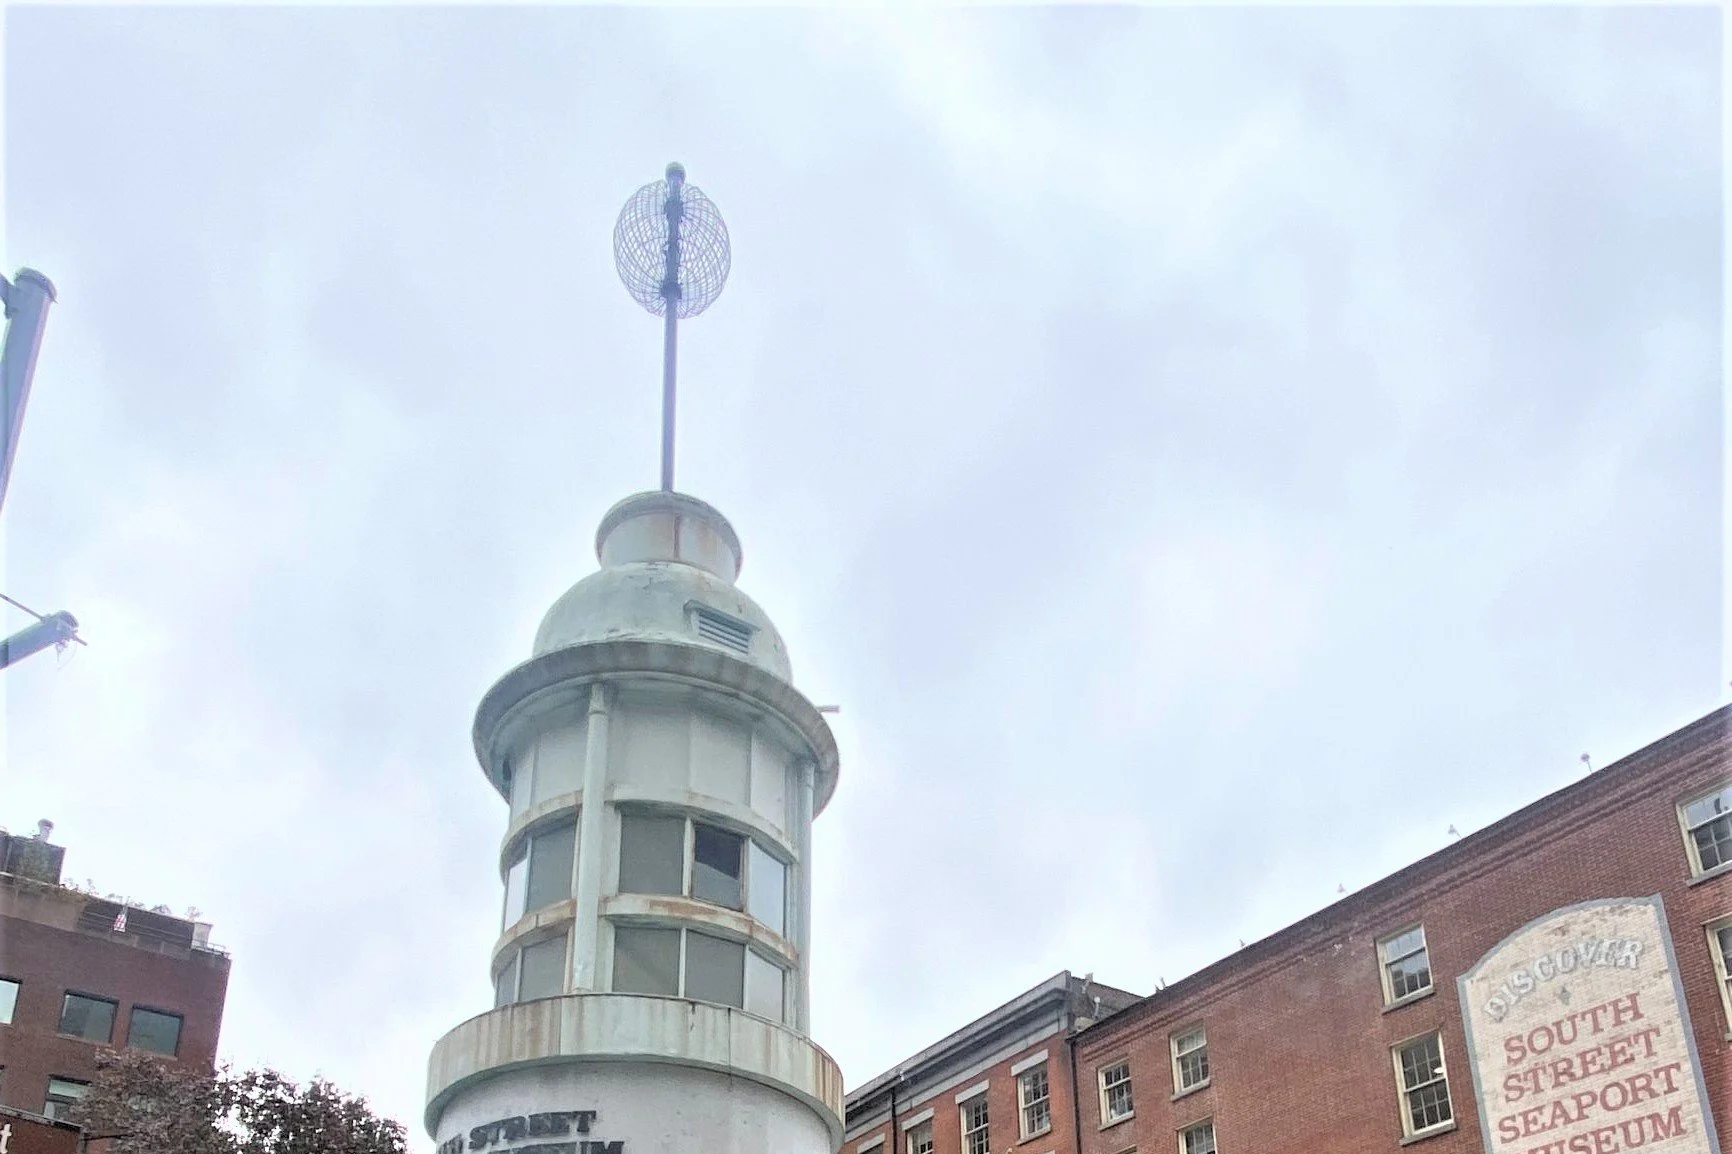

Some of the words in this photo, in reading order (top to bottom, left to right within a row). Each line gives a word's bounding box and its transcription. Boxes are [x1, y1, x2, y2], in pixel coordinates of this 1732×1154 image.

[1484, 938, 1643, 1023] DISCOVER
[1502, 1027, 1661, 1104] STREET
[1503, 991, 1645, 1067] SOUTH
[1498, 1062, 1682, 1145] SEAPORT
